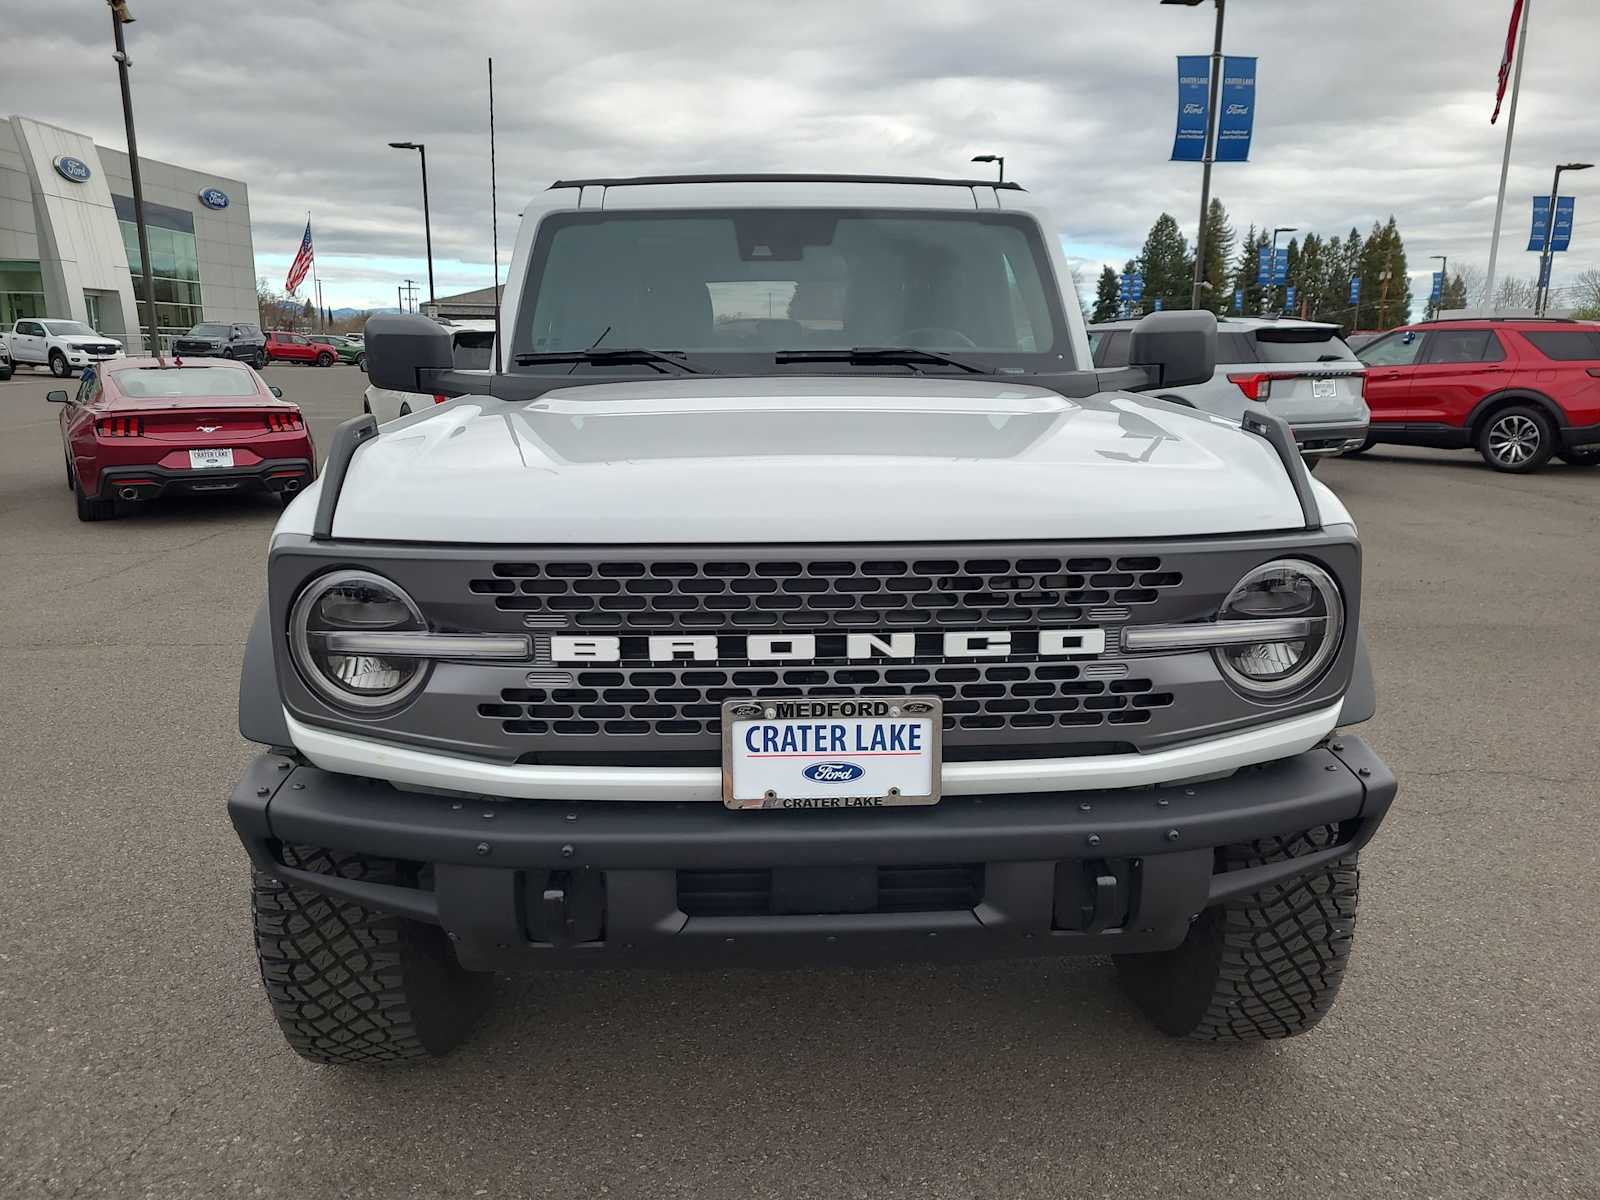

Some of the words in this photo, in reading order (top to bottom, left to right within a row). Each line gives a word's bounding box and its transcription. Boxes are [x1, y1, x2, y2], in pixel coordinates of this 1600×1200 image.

[1183, 103, 1204, 114] Ford
[1226, 103, 1249, 114] Ford
[551, 628, 1106, 662] BRONCO
[776, 701, 889, 718] MEDFORD
[745, 724, 847, 753] CRATER
[856, 723, 922, 751] LAKE
[783, 797, 840, 808] CRATER
[844, 796, 884, 807] LAKE
